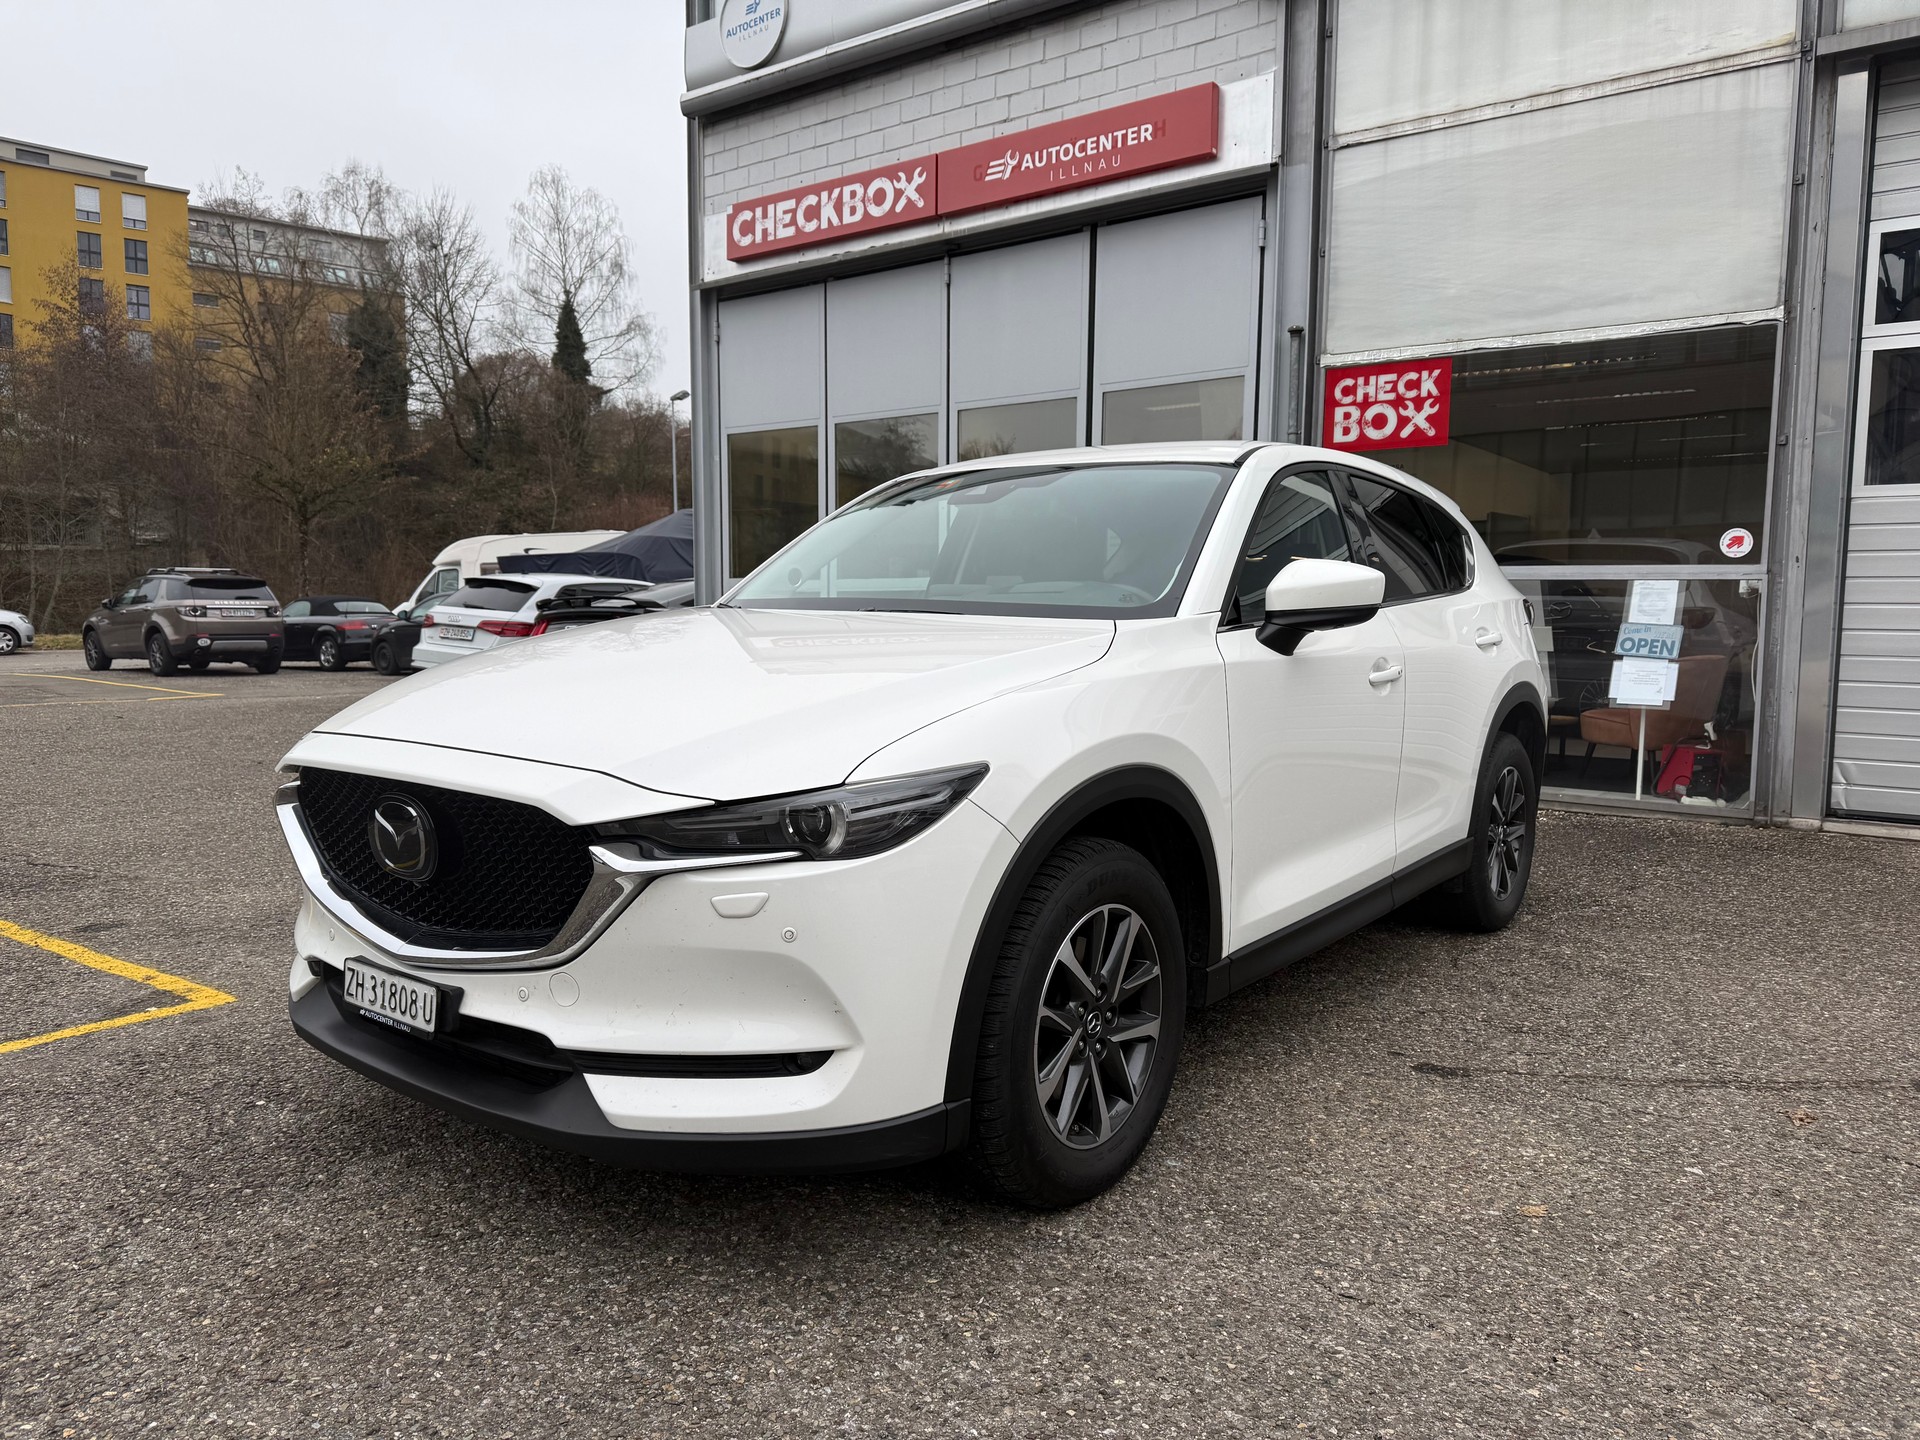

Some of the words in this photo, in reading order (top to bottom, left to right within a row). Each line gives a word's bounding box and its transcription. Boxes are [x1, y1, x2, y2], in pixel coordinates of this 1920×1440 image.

[726, 8, 781, 38] AUTOCENTER
[739, 25, 769, 42] ILLNAU
[1021, 123, 1153, 171] AUTOCENTER
[1050, 154, 1121, 181] ILLNAU
[732, 166, 927, 247] CHECKBOX
[1334, 369, 1442, 404] CHECK
[1333, 398, 1440, 443] BOX
[1619, 637, 1676, 656] OPEN
[365, 1010, 394, 1026] AUTOCENTER
[393, 1021, 411, 1033] ILLNAU
